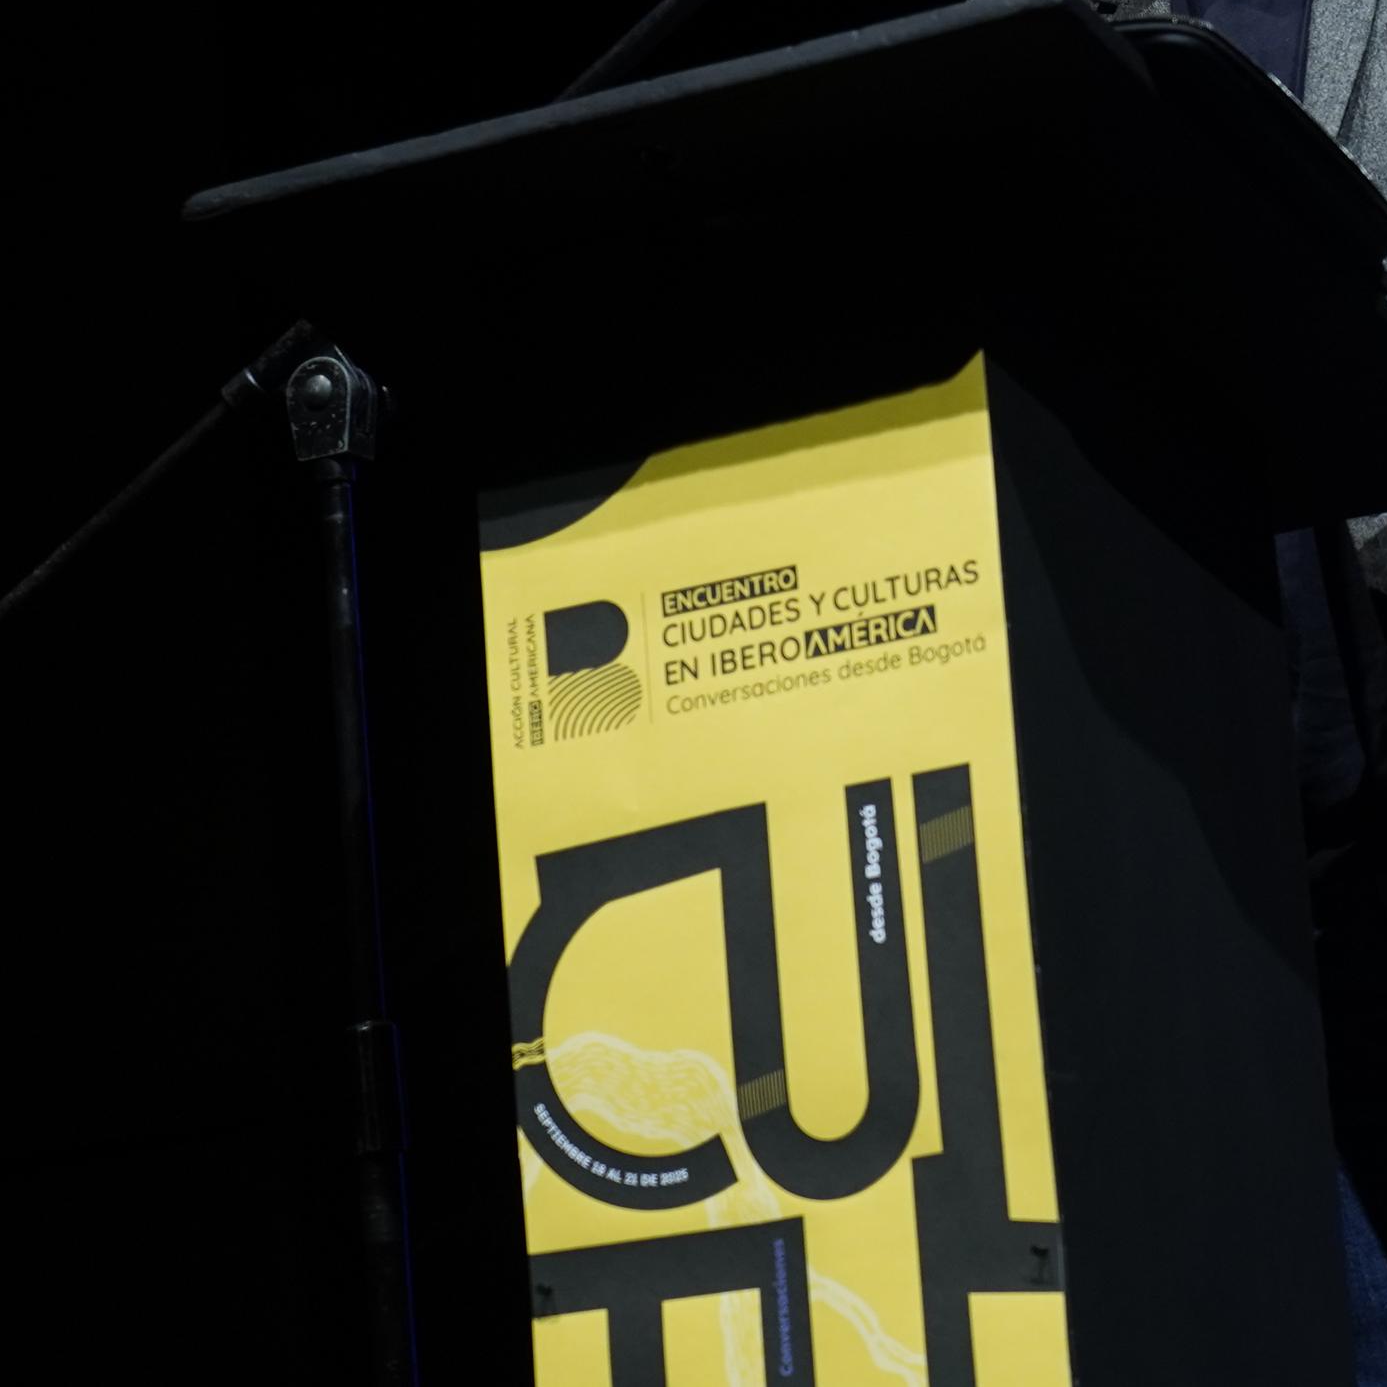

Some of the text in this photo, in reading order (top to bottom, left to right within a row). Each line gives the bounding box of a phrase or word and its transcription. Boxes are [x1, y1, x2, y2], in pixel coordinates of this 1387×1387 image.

[662, 559, 980, 648] CIUDADES Y CULTURAS
[663, 566, 797, 616] ENCUENTRO
[507, 616, 522, 692] CULTURAL
[664, 657, 699, 686] EN
[667, 632, 987, 716] Conversaciones desde Bogotá
[858, 804, 887, 945] desde Bogotá
[533, 1103, 593, 1170] SEPTIEMBRE
[605, 1167, 622, 1184] AL
[639, 1172, 659, 1187] DE
